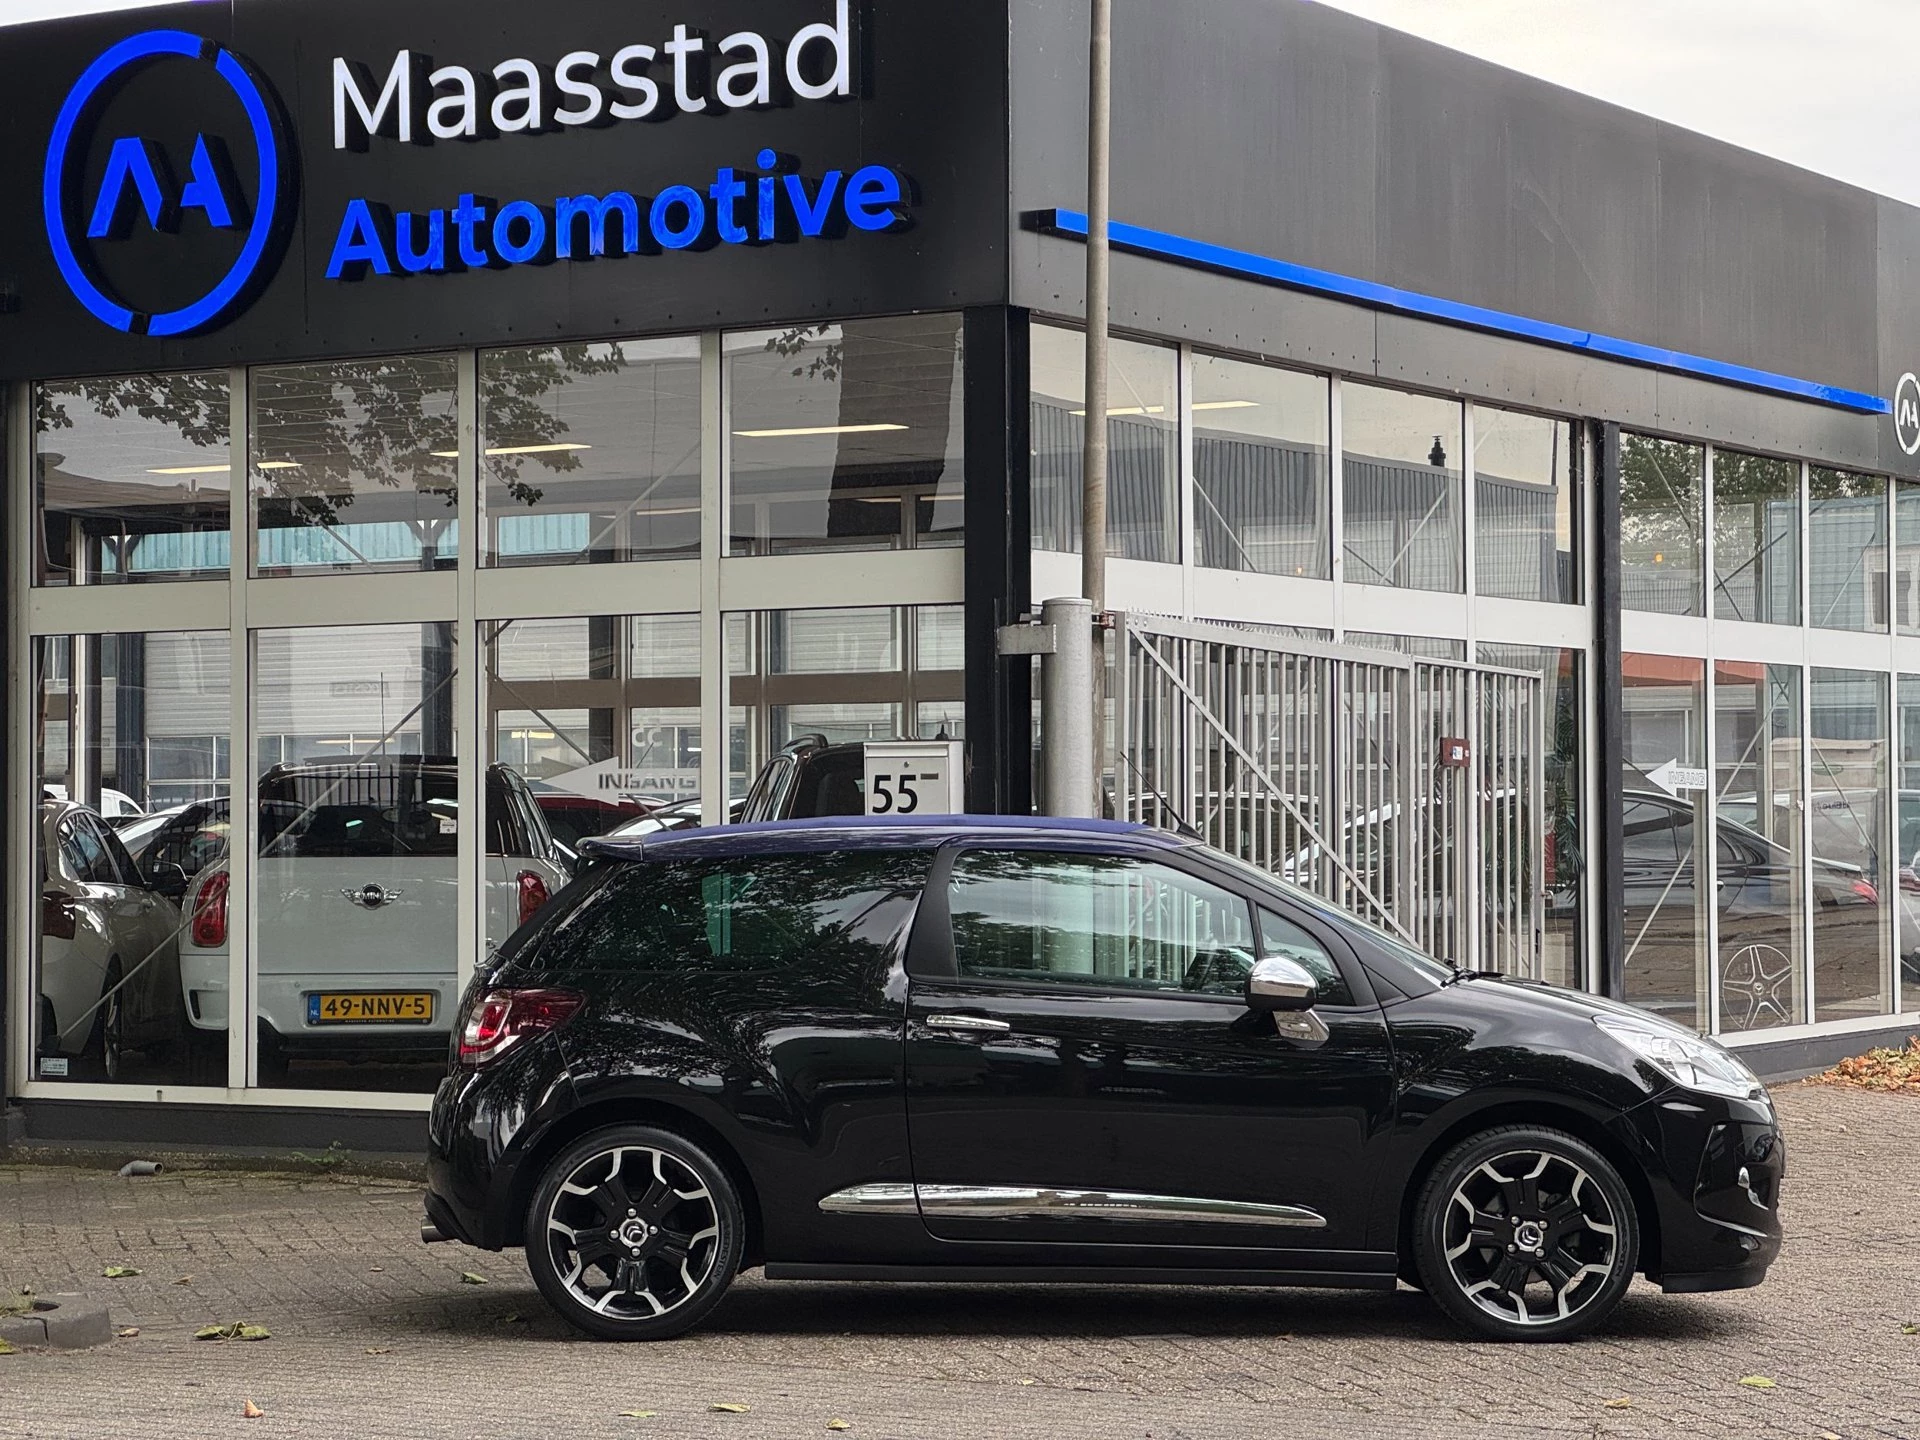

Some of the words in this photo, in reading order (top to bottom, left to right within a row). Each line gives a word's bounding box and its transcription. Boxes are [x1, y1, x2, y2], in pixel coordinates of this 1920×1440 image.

[332, 0, 851, 150] Maasstad
[324, 148, 901, 279] Automotive
[872, 774, 918, 814] 55
[325, 997, 425, 1016] 49-NNV-5
